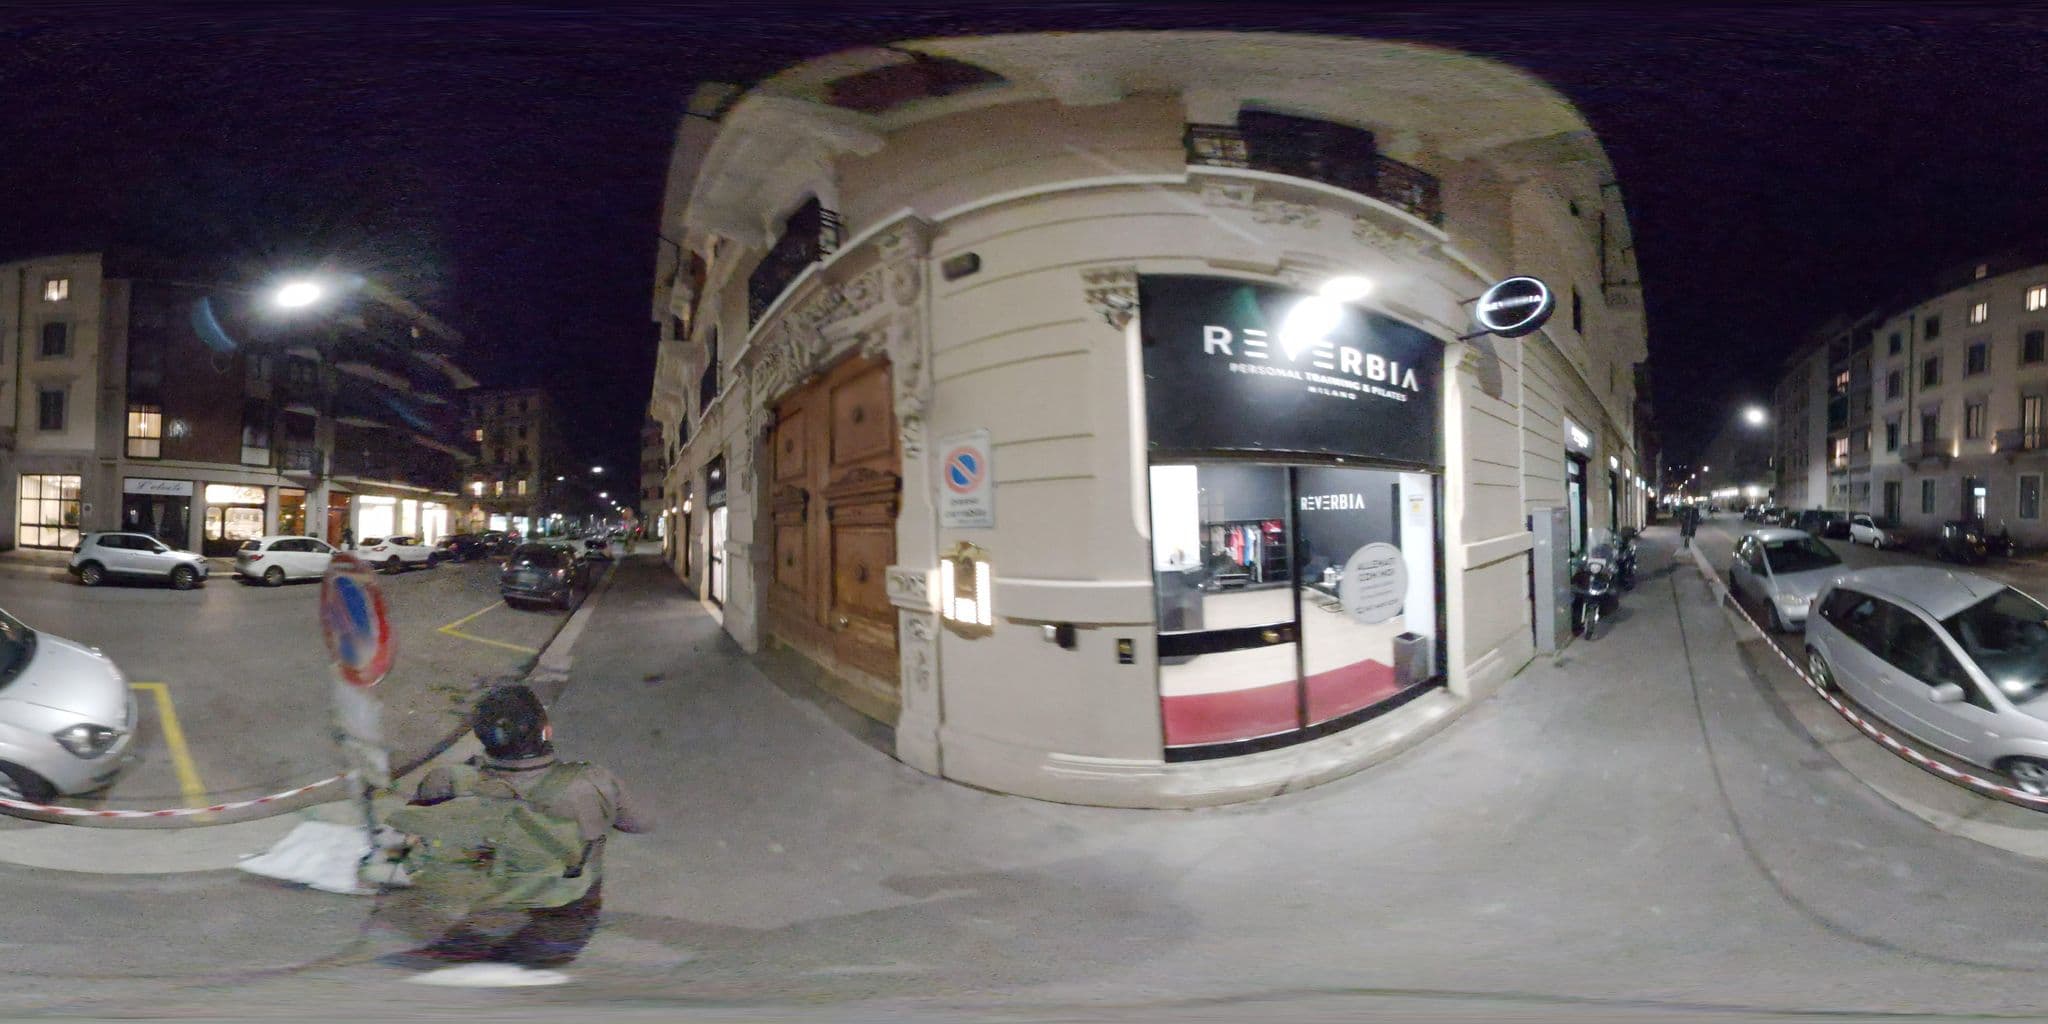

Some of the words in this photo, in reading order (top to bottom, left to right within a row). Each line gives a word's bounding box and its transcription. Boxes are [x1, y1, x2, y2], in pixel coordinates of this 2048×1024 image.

[1203, 325, 1419, 392] REVERBIA
[1229, 362, 1303, 380] PERSONAL
[1305, 371, 1361, 391] TRAINING
[1371, 386, 1408, 402] PILATES
[1308, 386, 1356, 400] MILANO
[1300, 493, 1365, 511] REVERBIA
